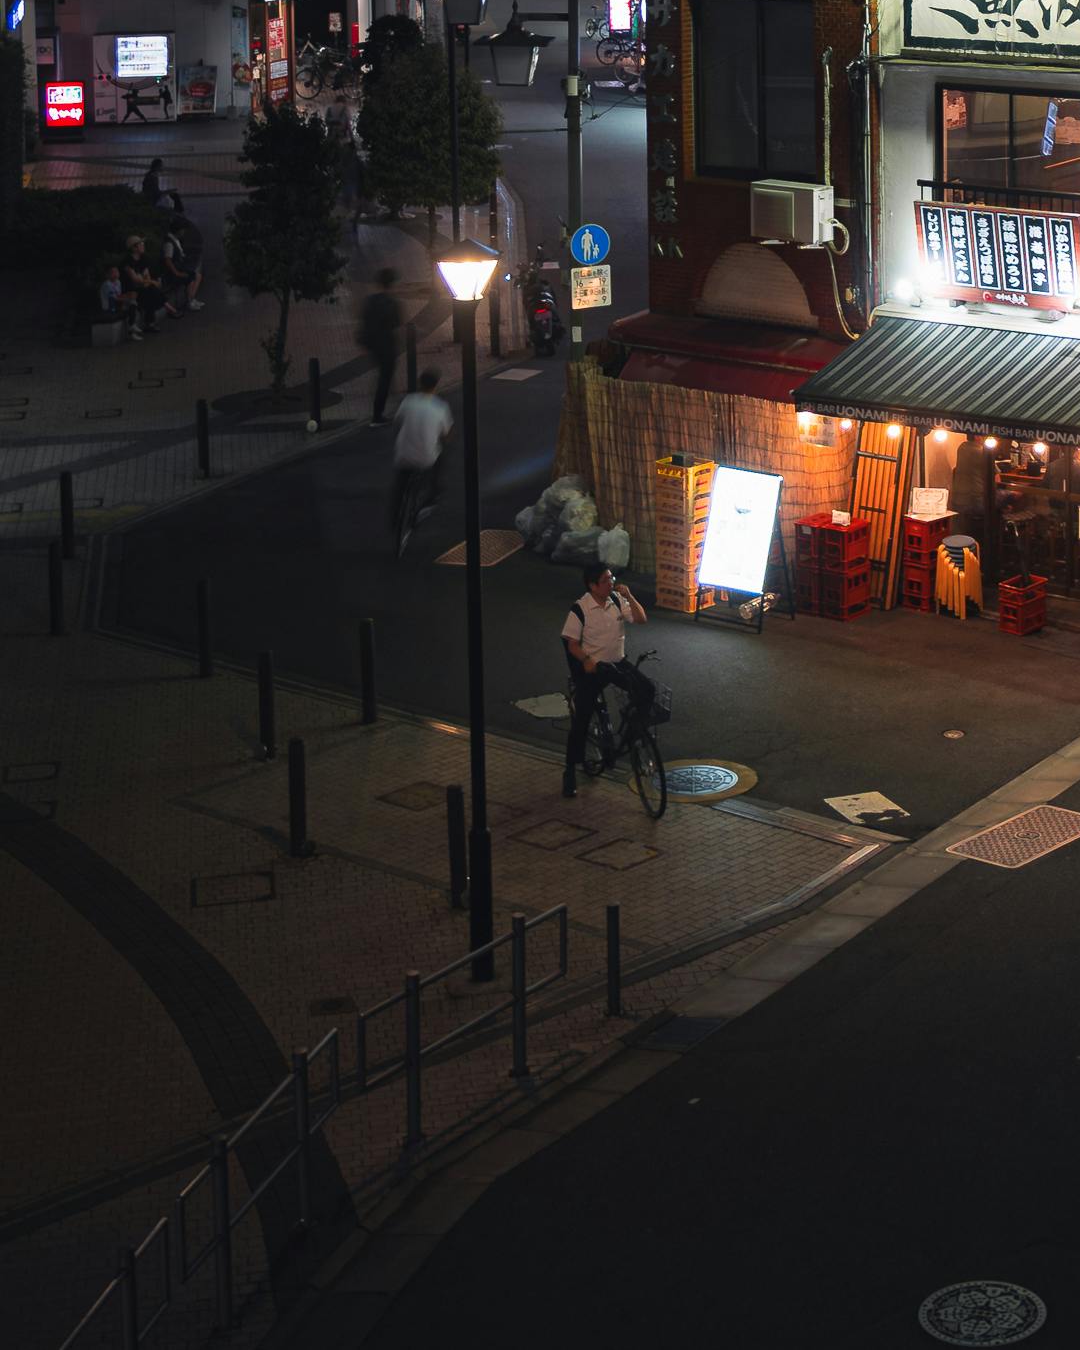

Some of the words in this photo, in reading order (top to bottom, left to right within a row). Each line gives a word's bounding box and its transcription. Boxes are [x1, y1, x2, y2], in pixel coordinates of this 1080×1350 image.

[576, 280, 584, 288] 16
[599, 277, 607, 285] 19
[601, 295, 607, 304] 9
[817, 403, 836, 413] BAR
[836, 405, 889, 422] UONAMI
[891, 413, 912, 424] FISH
[913, 416, 932, 426] BAR
[933, 417, 989, 434] UONAMI
[992, 425, 1013, 436] FISH
[1015, 428, 1034, 439] BAR
